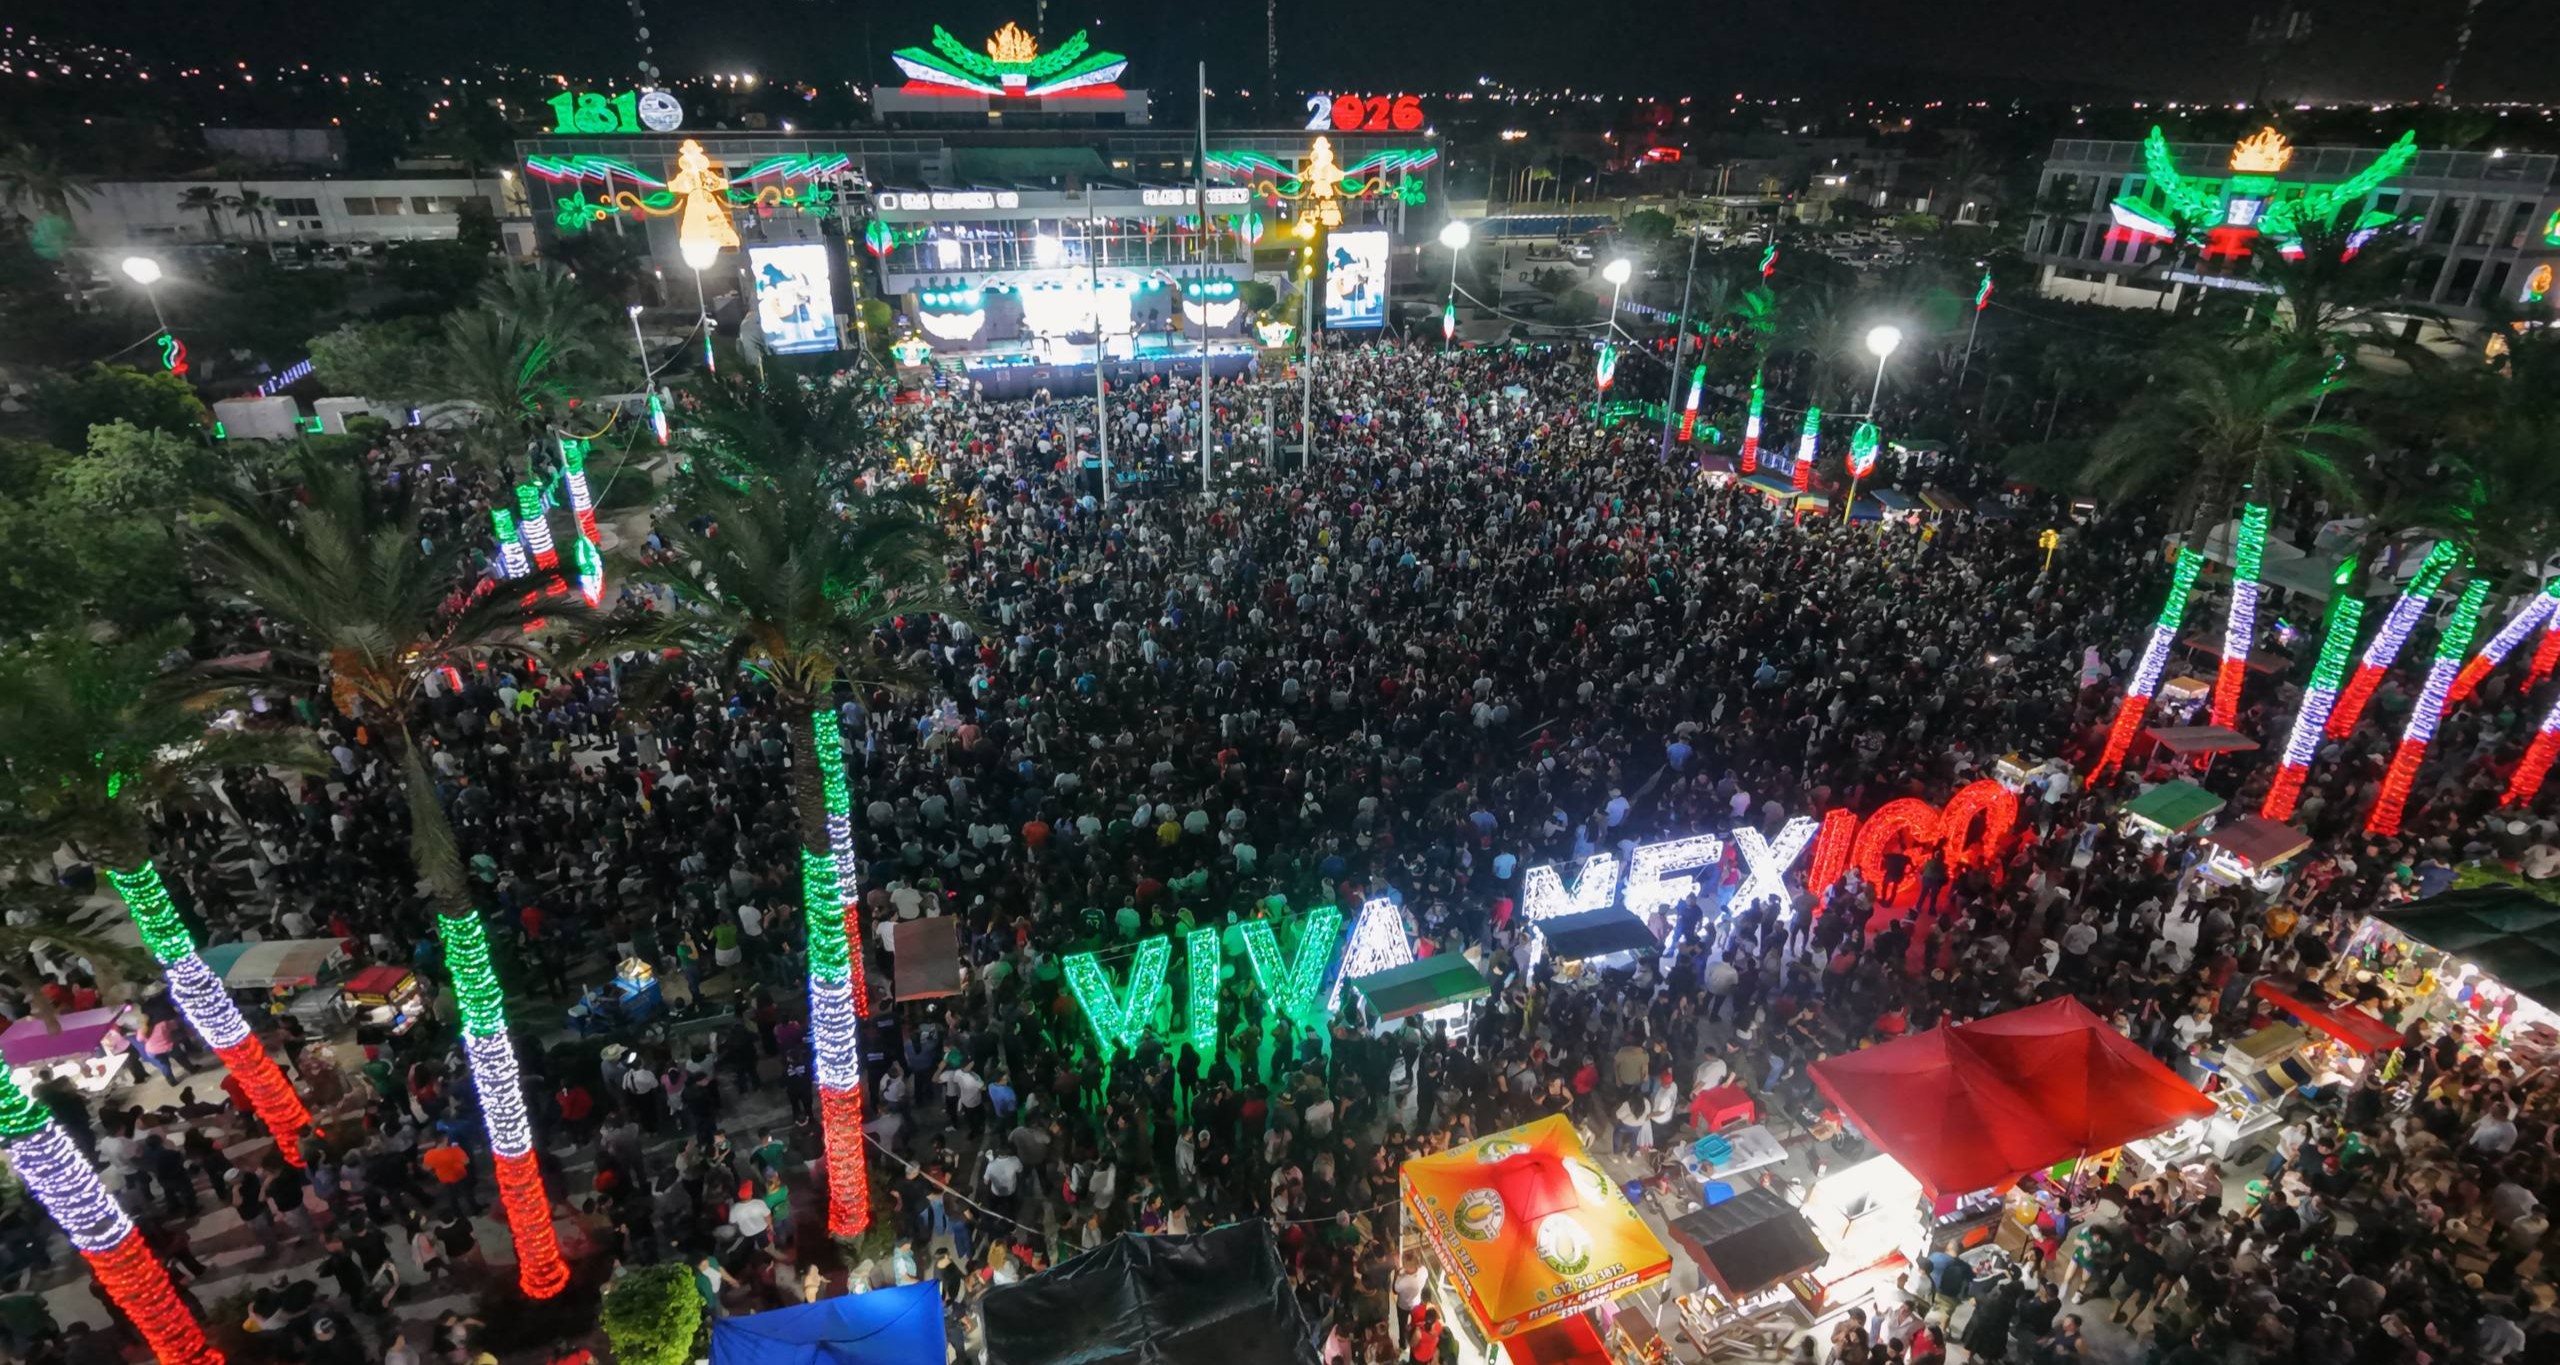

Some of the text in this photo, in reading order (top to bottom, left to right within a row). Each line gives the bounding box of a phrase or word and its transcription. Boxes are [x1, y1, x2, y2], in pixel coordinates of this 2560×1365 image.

[547, 90, 683, 133] 1810
[1305, 94, 1424, 131] 2026
[1062, 897, 1414, 1052] VIVA
[1434, 1208, 1479, 1277] 612 218 3875
[1552, 1263, 1625, 1297] 612 218 3875
